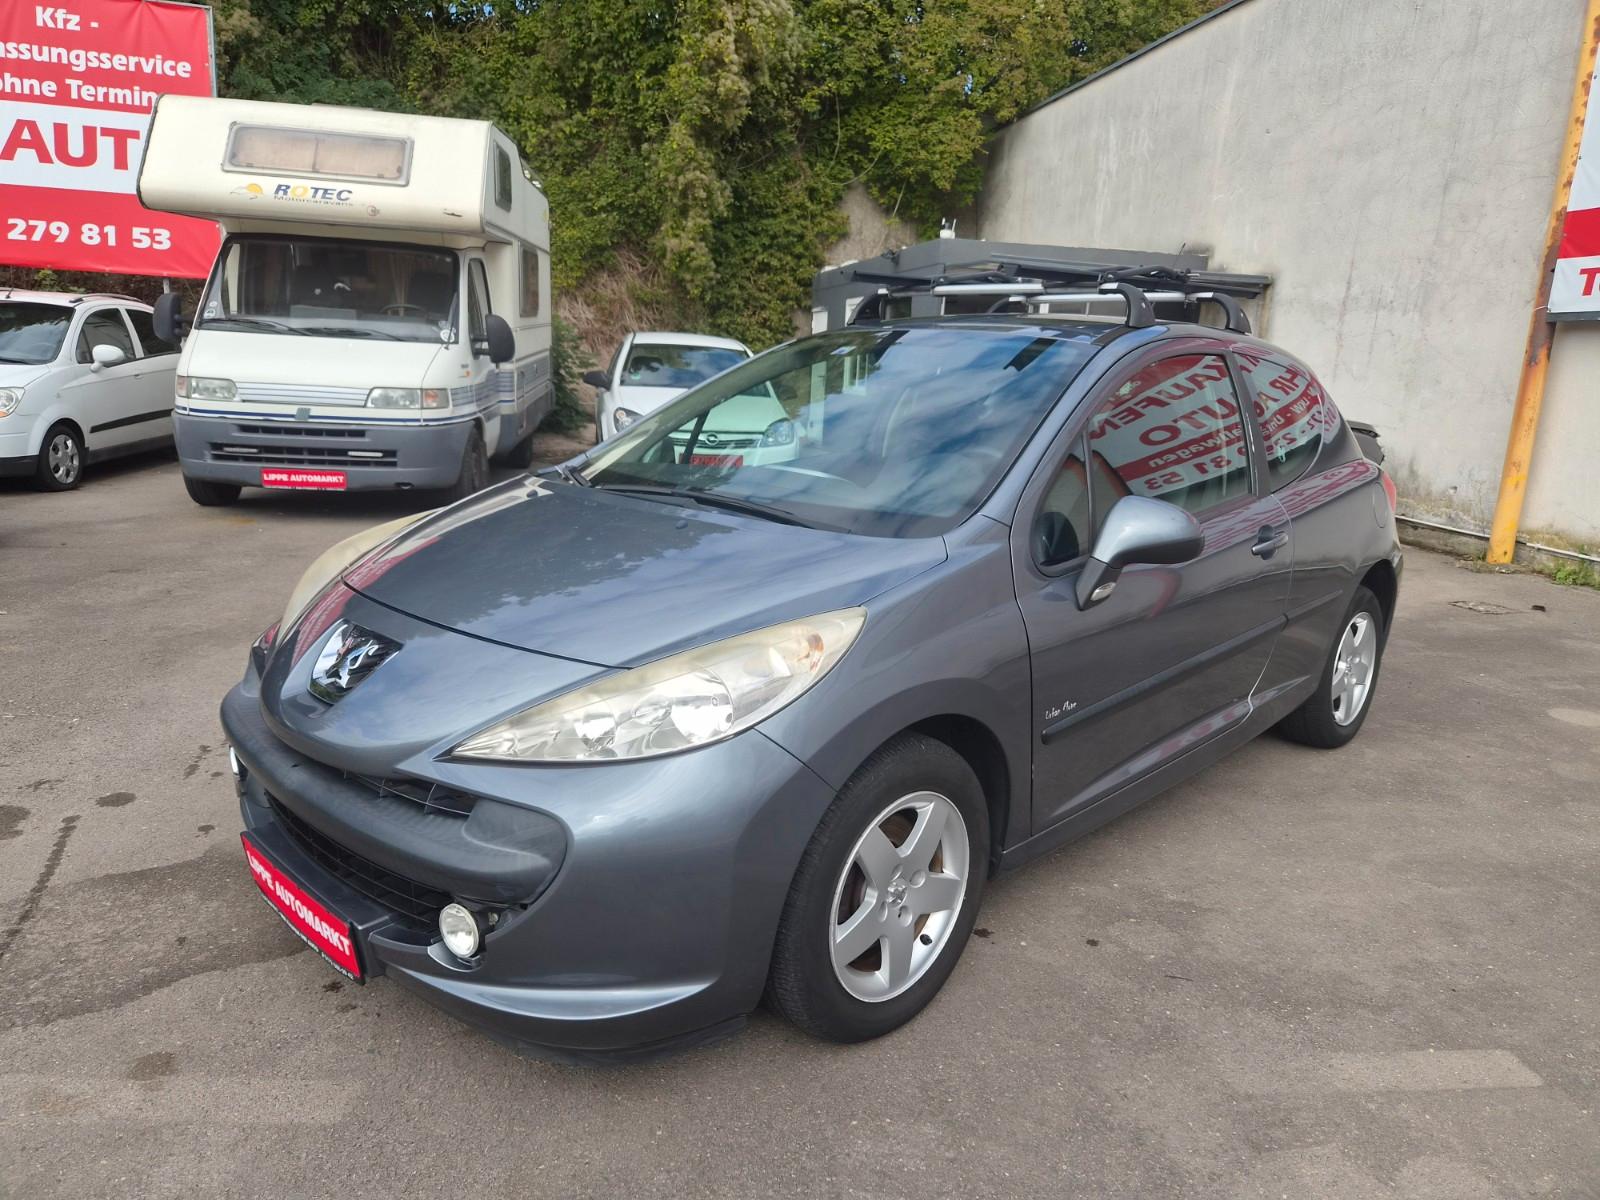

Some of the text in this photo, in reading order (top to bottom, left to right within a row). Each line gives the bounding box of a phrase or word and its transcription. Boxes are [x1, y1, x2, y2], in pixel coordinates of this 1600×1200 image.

[35, 6, 81, 31] Kfz
[65, 78, 157, 107] Termin
[274, 183, 353, 201] ROTEC
[7, 218, 171, 250] 279 81 53
[263, 473, 344, 483] LIPPE AUTOMARKT
[275, 880, 351, 957] AUTOMARKT
